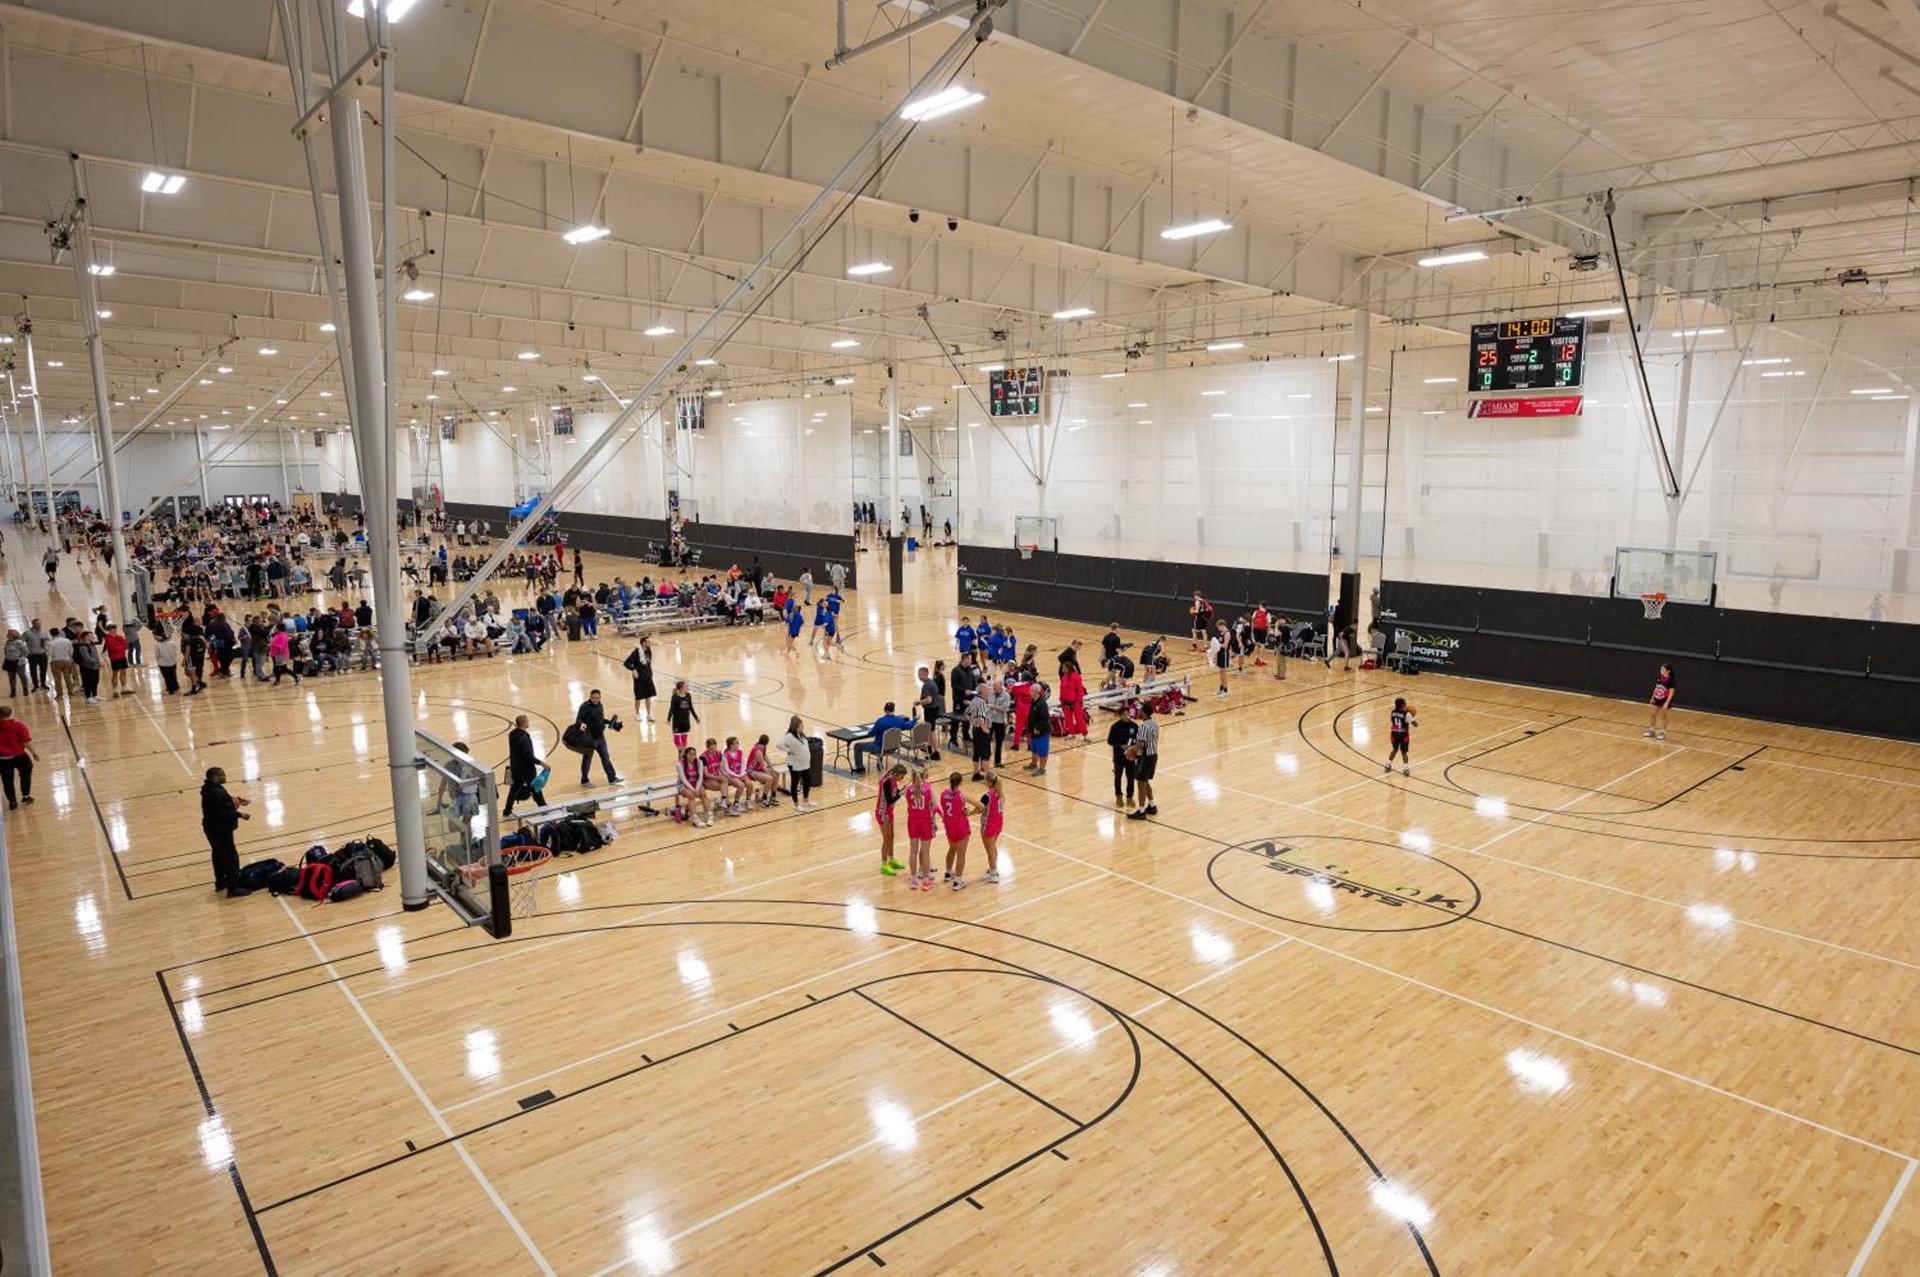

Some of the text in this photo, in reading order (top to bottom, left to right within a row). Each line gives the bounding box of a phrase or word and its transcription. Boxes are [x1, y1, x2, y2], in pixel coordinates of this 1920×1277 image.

[1508, 320, 1550, 336] 14:00
[1550, 336, 1579, 346] VISITOR
[1479, 350, 1497, 365] 25
[1529, 350, 1538, 363] 2
[1562, 345, 1576, 360] 12
[1484, 373, 1492, 385] 0
[1563, 368, 1571, 381] 0
[1411, 646, 1448, 657] PORTS
[1394, 717, 1402, 729] 4
[912, 795, 925, 810] 30
[946, 802, 953, 816] 2
[1263, 860, 1408, 908] SPORTS
